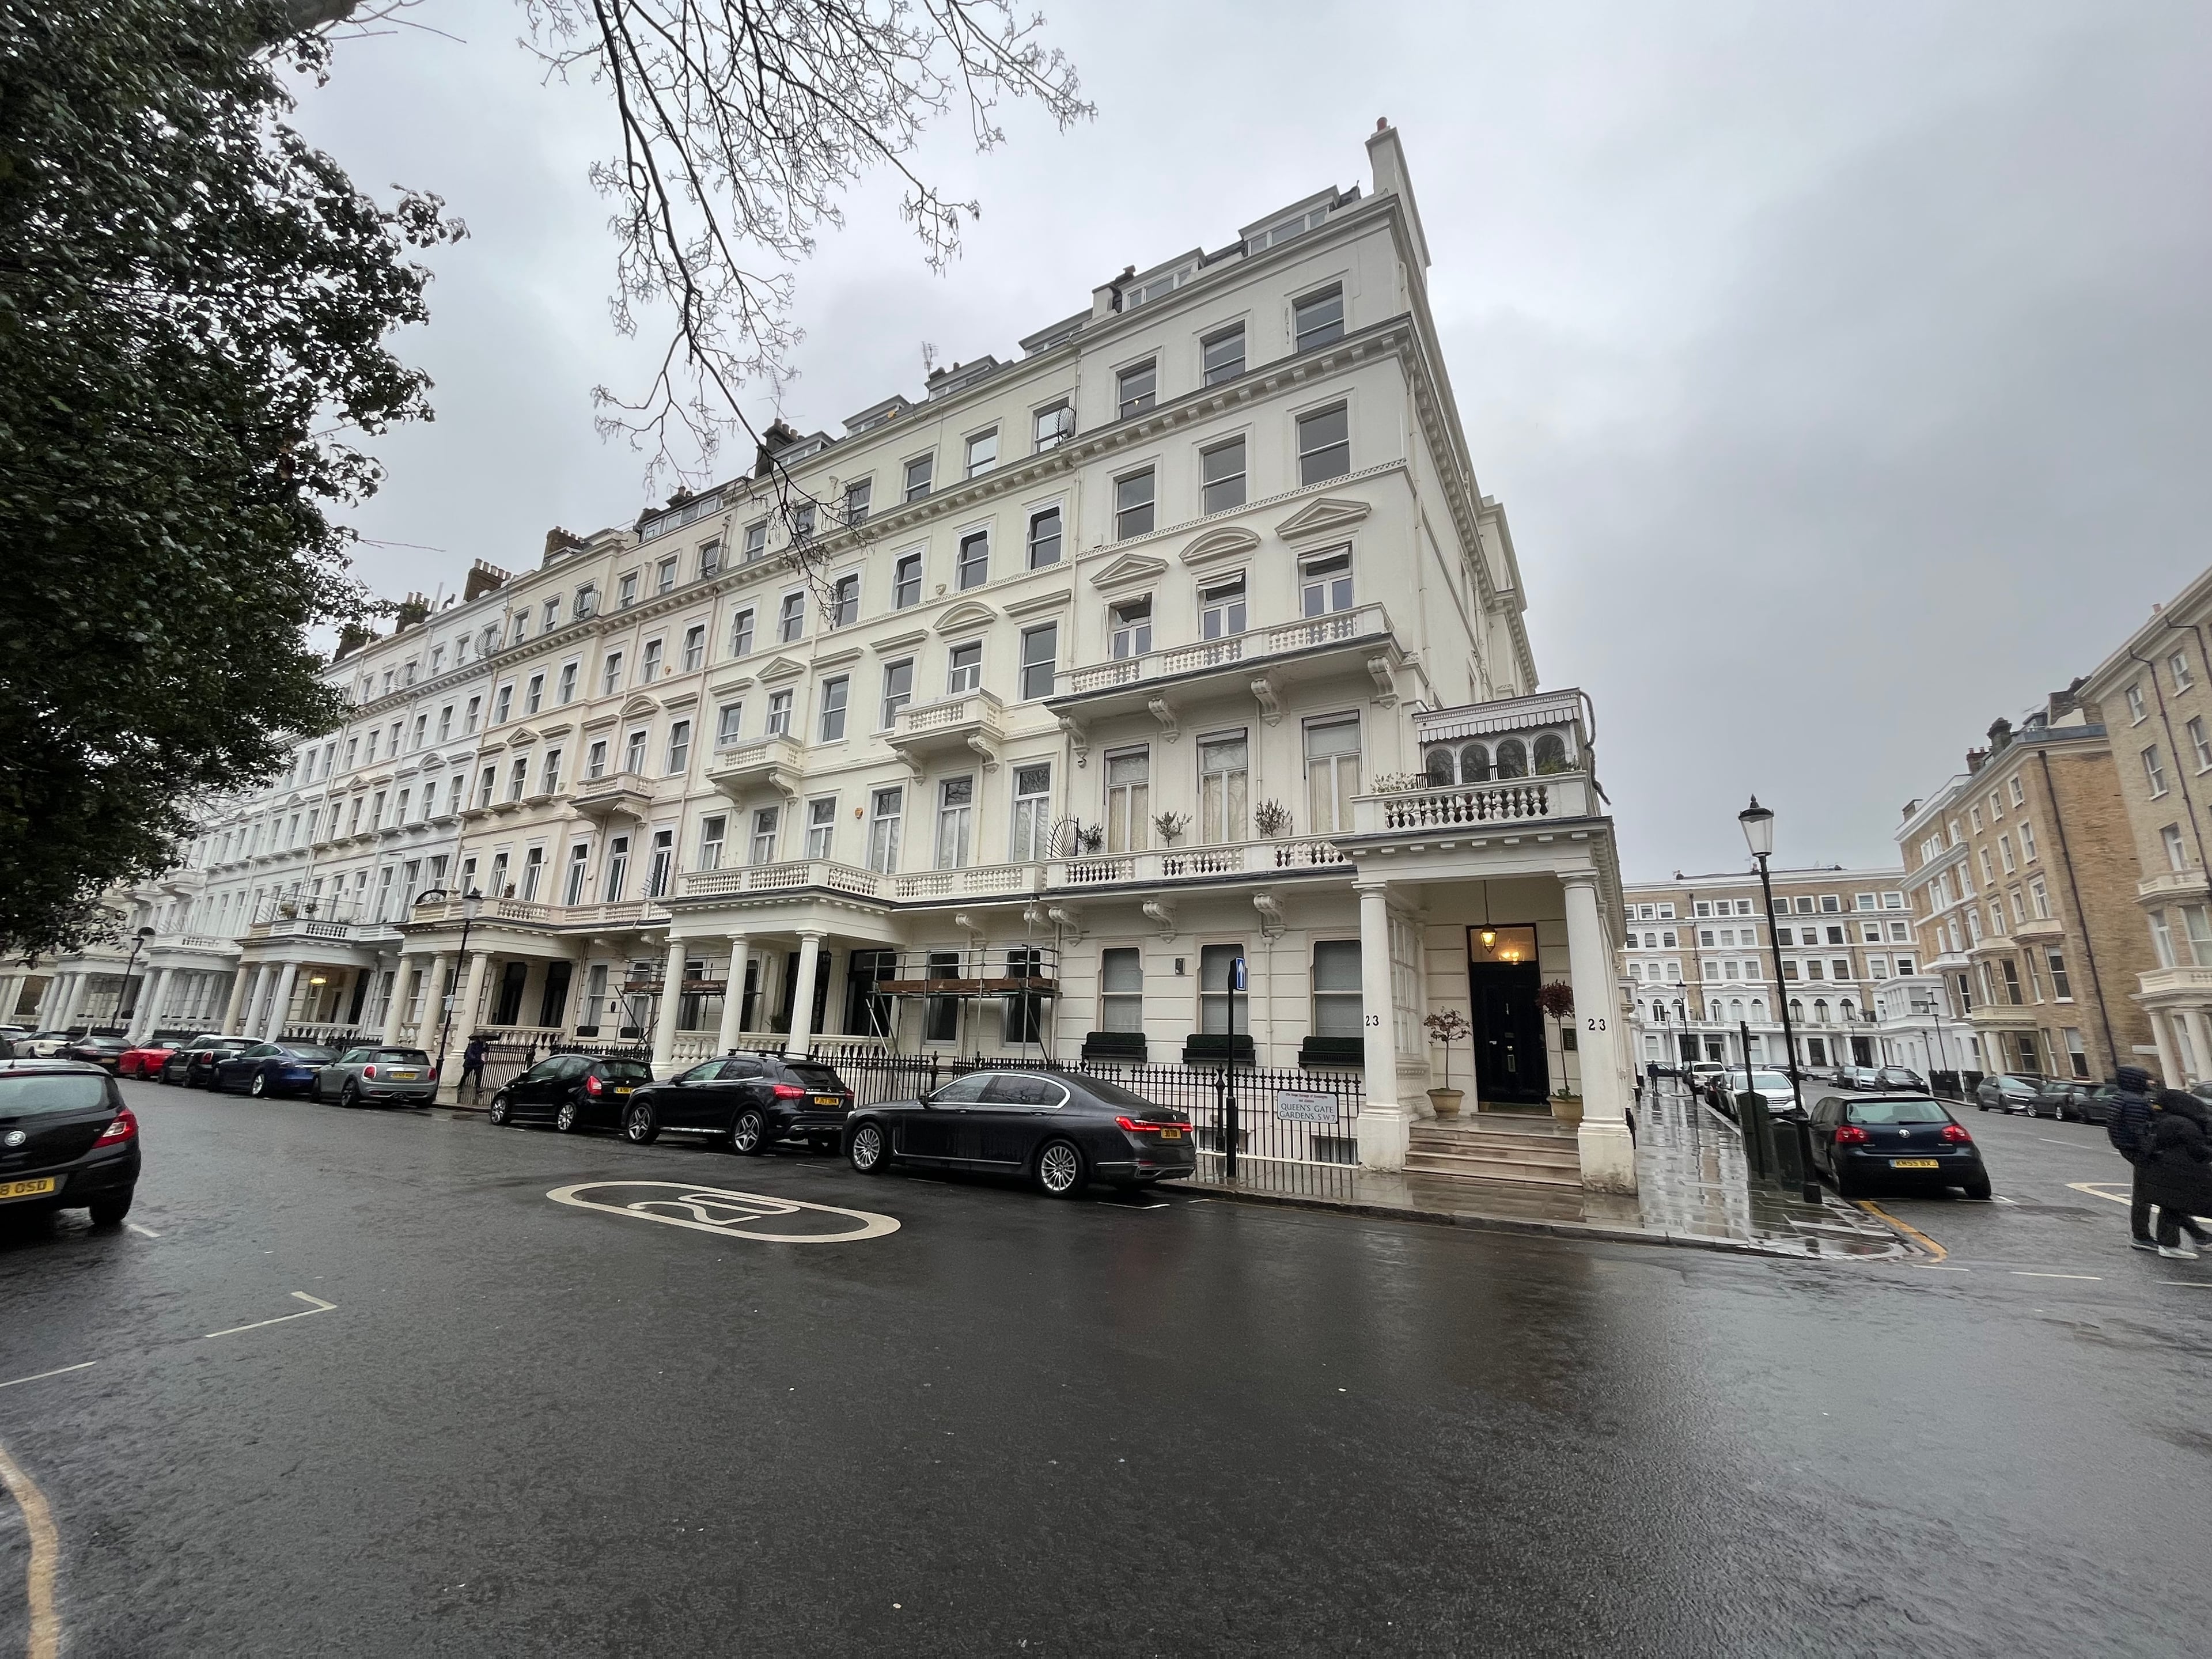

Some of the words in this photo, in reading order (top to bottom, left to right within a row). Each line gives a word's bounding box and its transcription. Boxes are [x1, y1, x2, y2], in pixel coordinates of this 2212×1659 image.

[1366, 1015, 1379, 1026] 23
[1588, 1018, 1606, 1031] 23
[1314, 1105, 1334, 1113] GATE
[627, 1193, 801, 1226] 20
